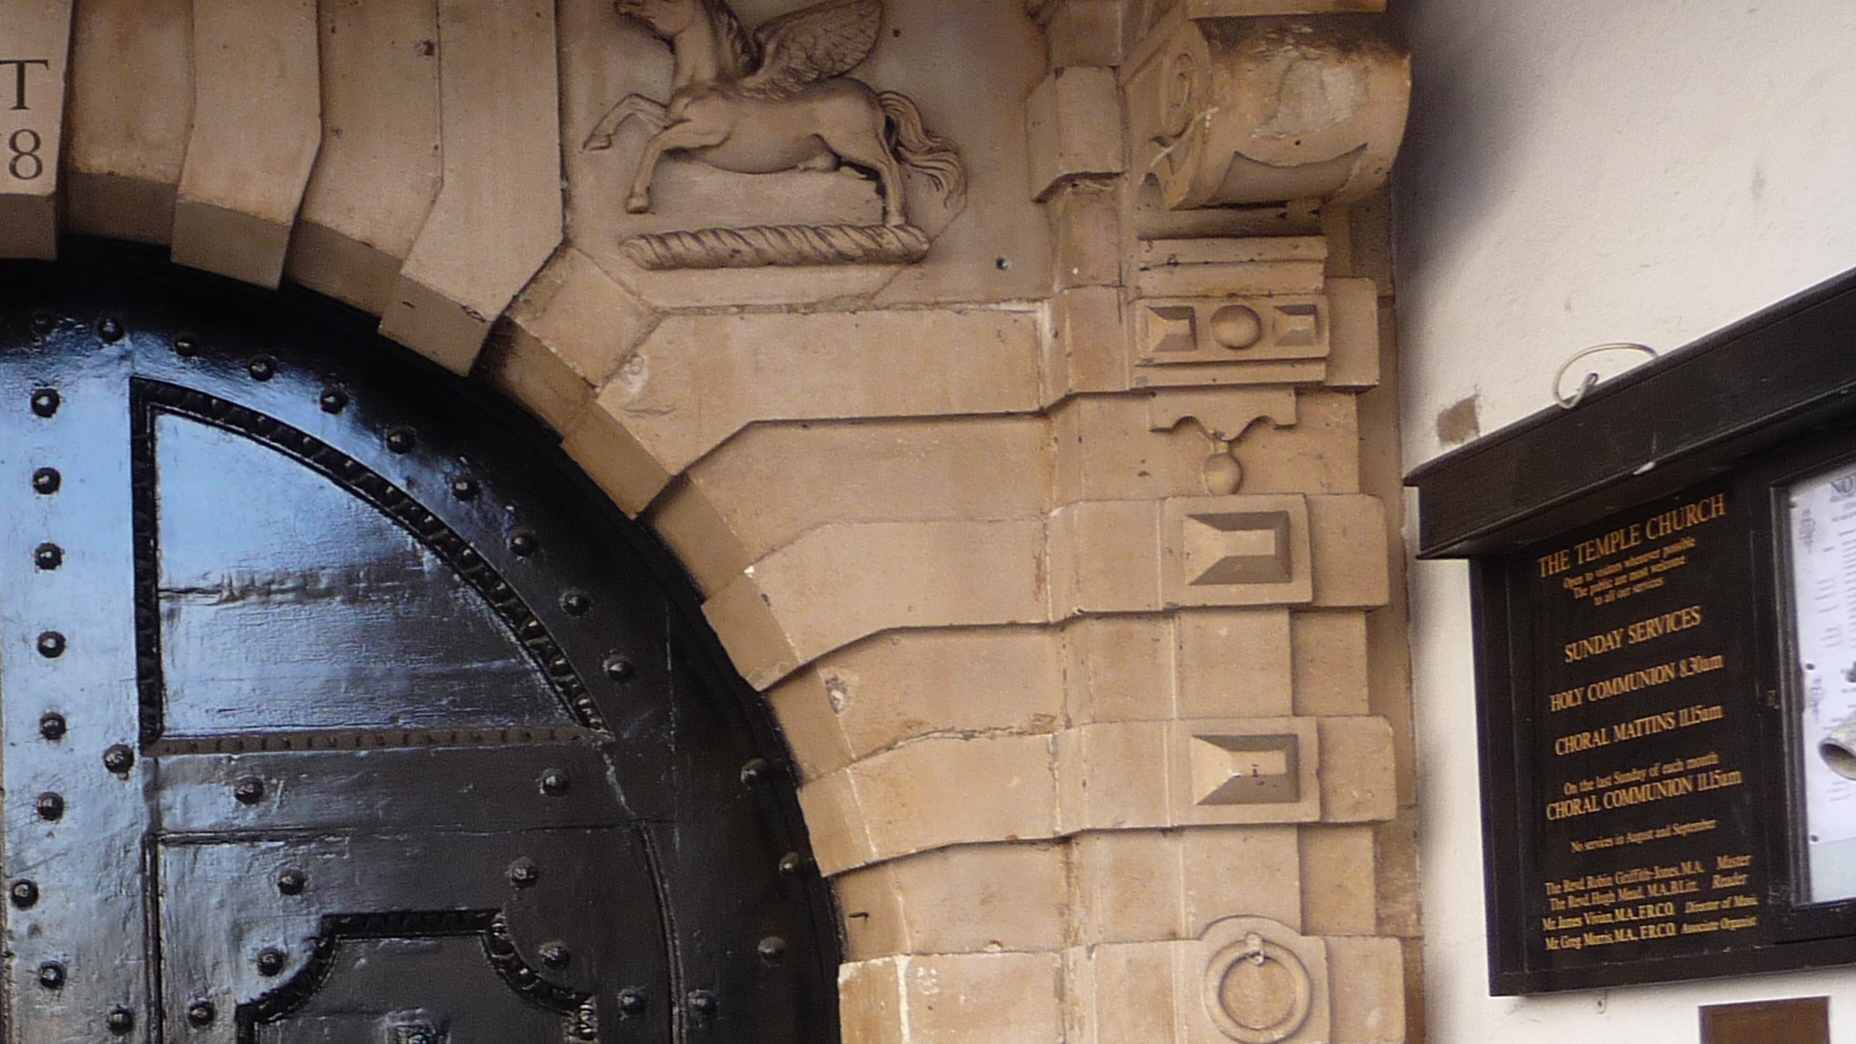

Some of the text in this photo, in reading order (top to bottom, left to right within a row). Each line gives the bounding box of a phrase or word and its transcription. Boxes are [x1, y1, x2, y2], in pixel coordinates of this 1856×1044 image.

[1538, 493, 1726, 578] THE TEMPLE CHURCH
[1564, 605, 1702, 663] SUNDAY SERVICES
[1550, 654, 1725, 712] HOLY COMMUNION 8.30am
[1555, 728, 1610, 756] CHORAL
[1614, 711, 1676, 742] MATTINS
[1564, 751, 1720, 795] On the last Sunday of each month
[1546, 795, 1601, 821] CHORAL
[1603, 775, 1695, 810] COMMUNION
[1571, 840, 1585, 853] No
